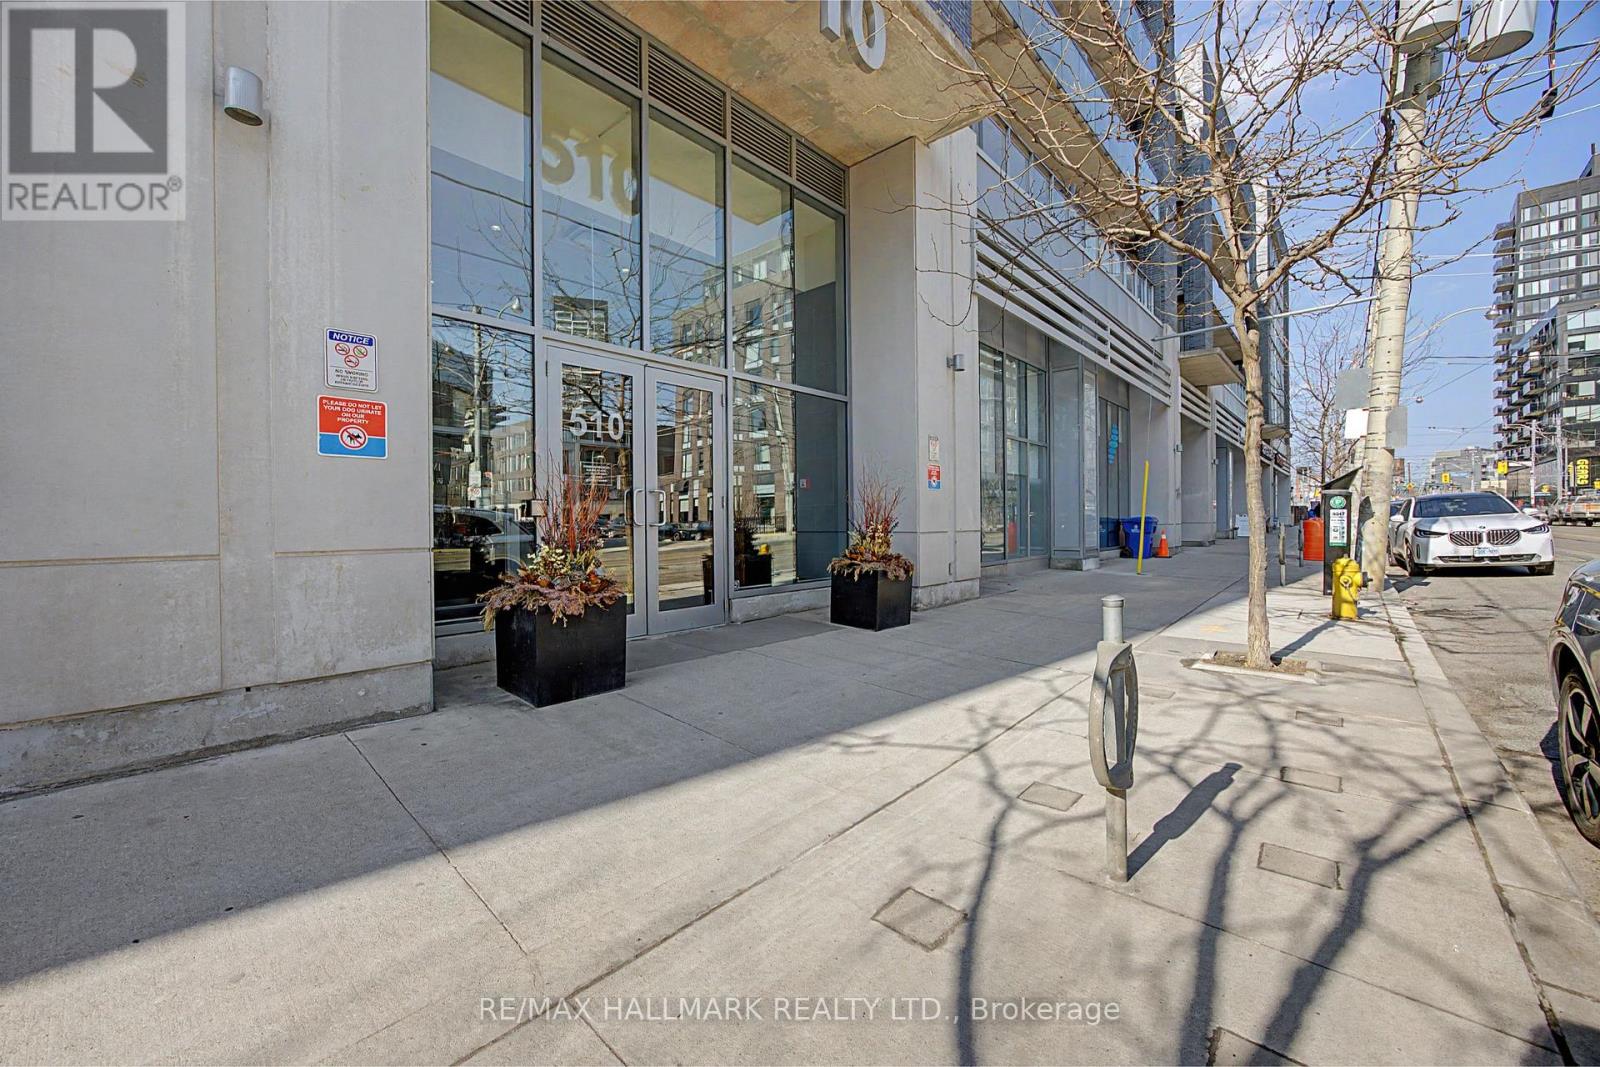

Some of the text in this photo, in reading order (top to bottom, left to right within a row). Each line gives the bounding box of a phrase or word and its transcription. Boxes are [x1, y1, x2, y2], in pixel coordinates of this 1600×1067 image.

[332, 332, 370, 345] NOTICE
[322, 399, 347, 407] PLEASE
[356, 408, 382, 416] URINATE
[569, 406, 624, 440] 510
[1576, 459, 1589, 485] GEARS
